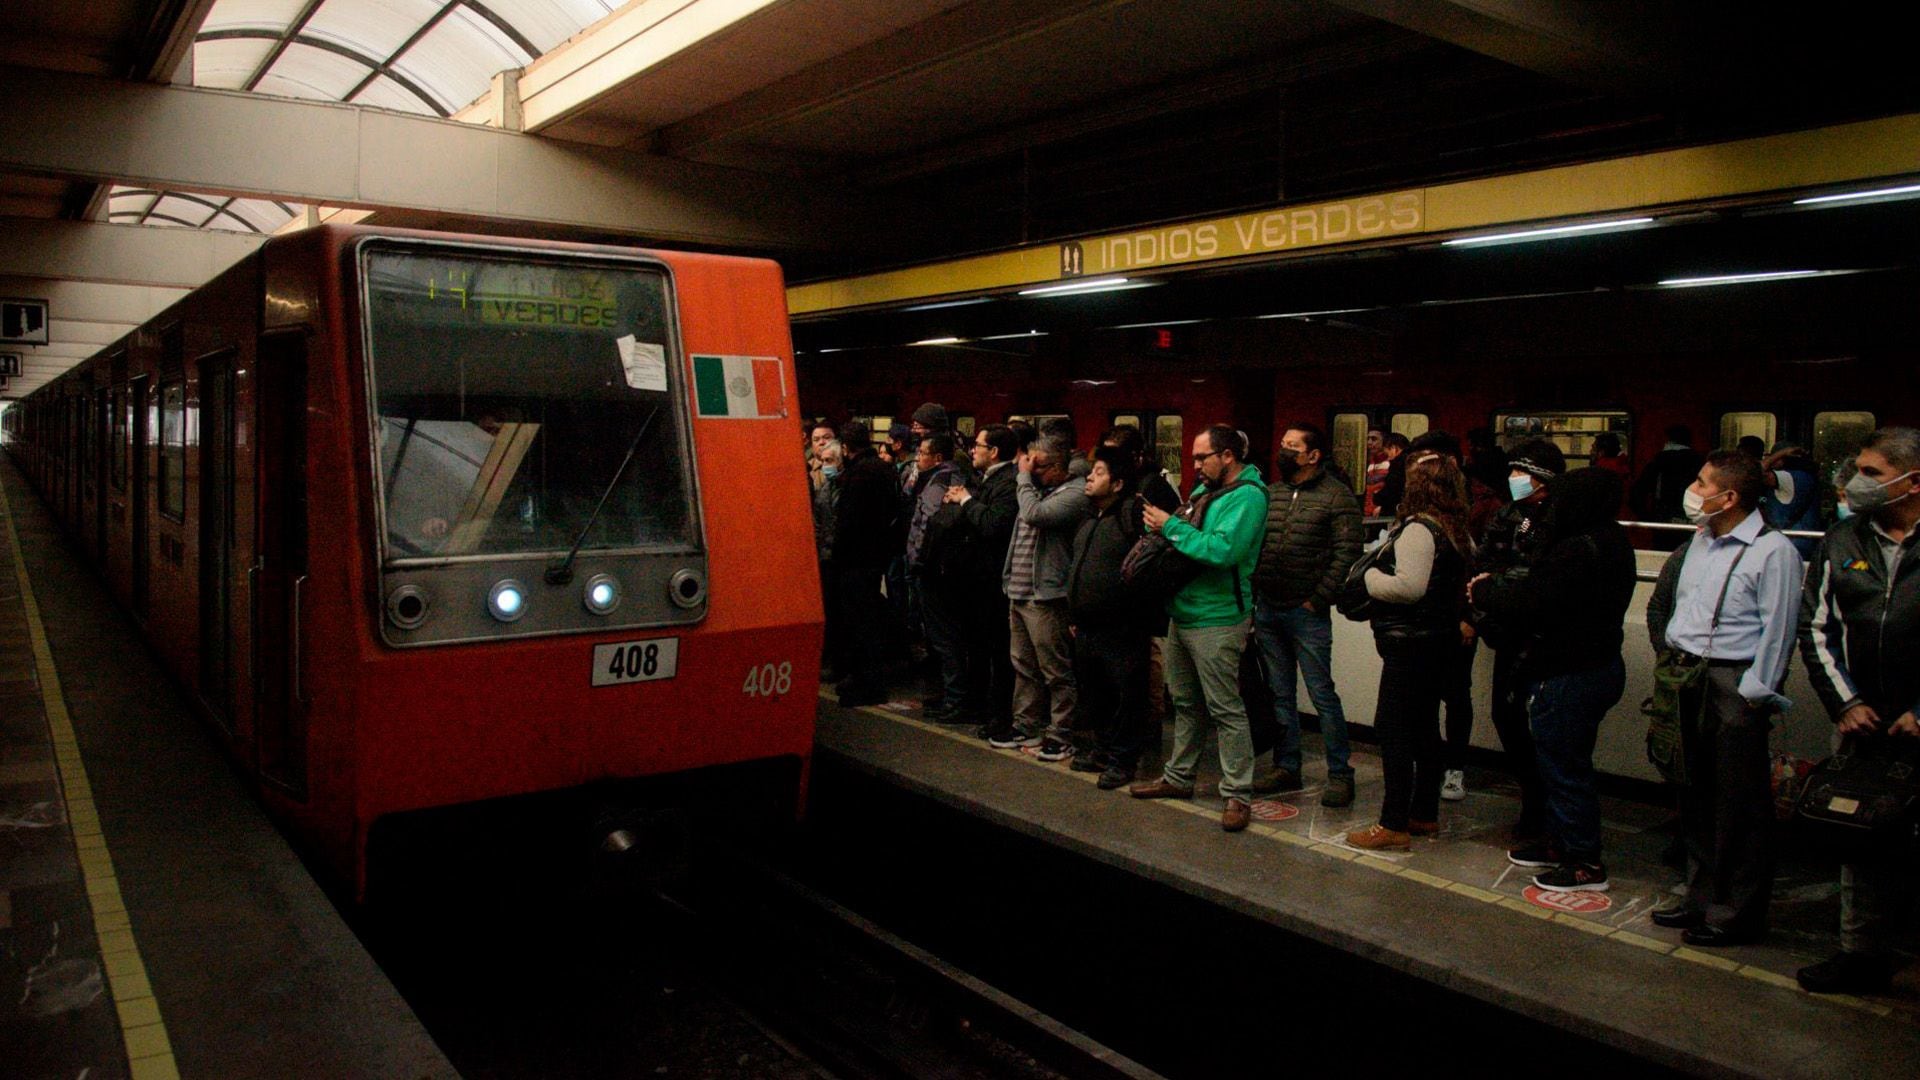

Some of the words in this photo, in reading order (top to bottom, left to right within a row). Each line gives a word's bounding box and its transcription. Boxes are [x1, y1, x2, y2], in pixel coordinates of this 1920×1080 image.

[1101, 225, 1219, 270] INDIOS
[1233, 193, 1421, 251] VERDES
[494, 299, 619, 328] VERDES
[608, 643, 659, 679] 408
[742, 660, 793, 698] 408
